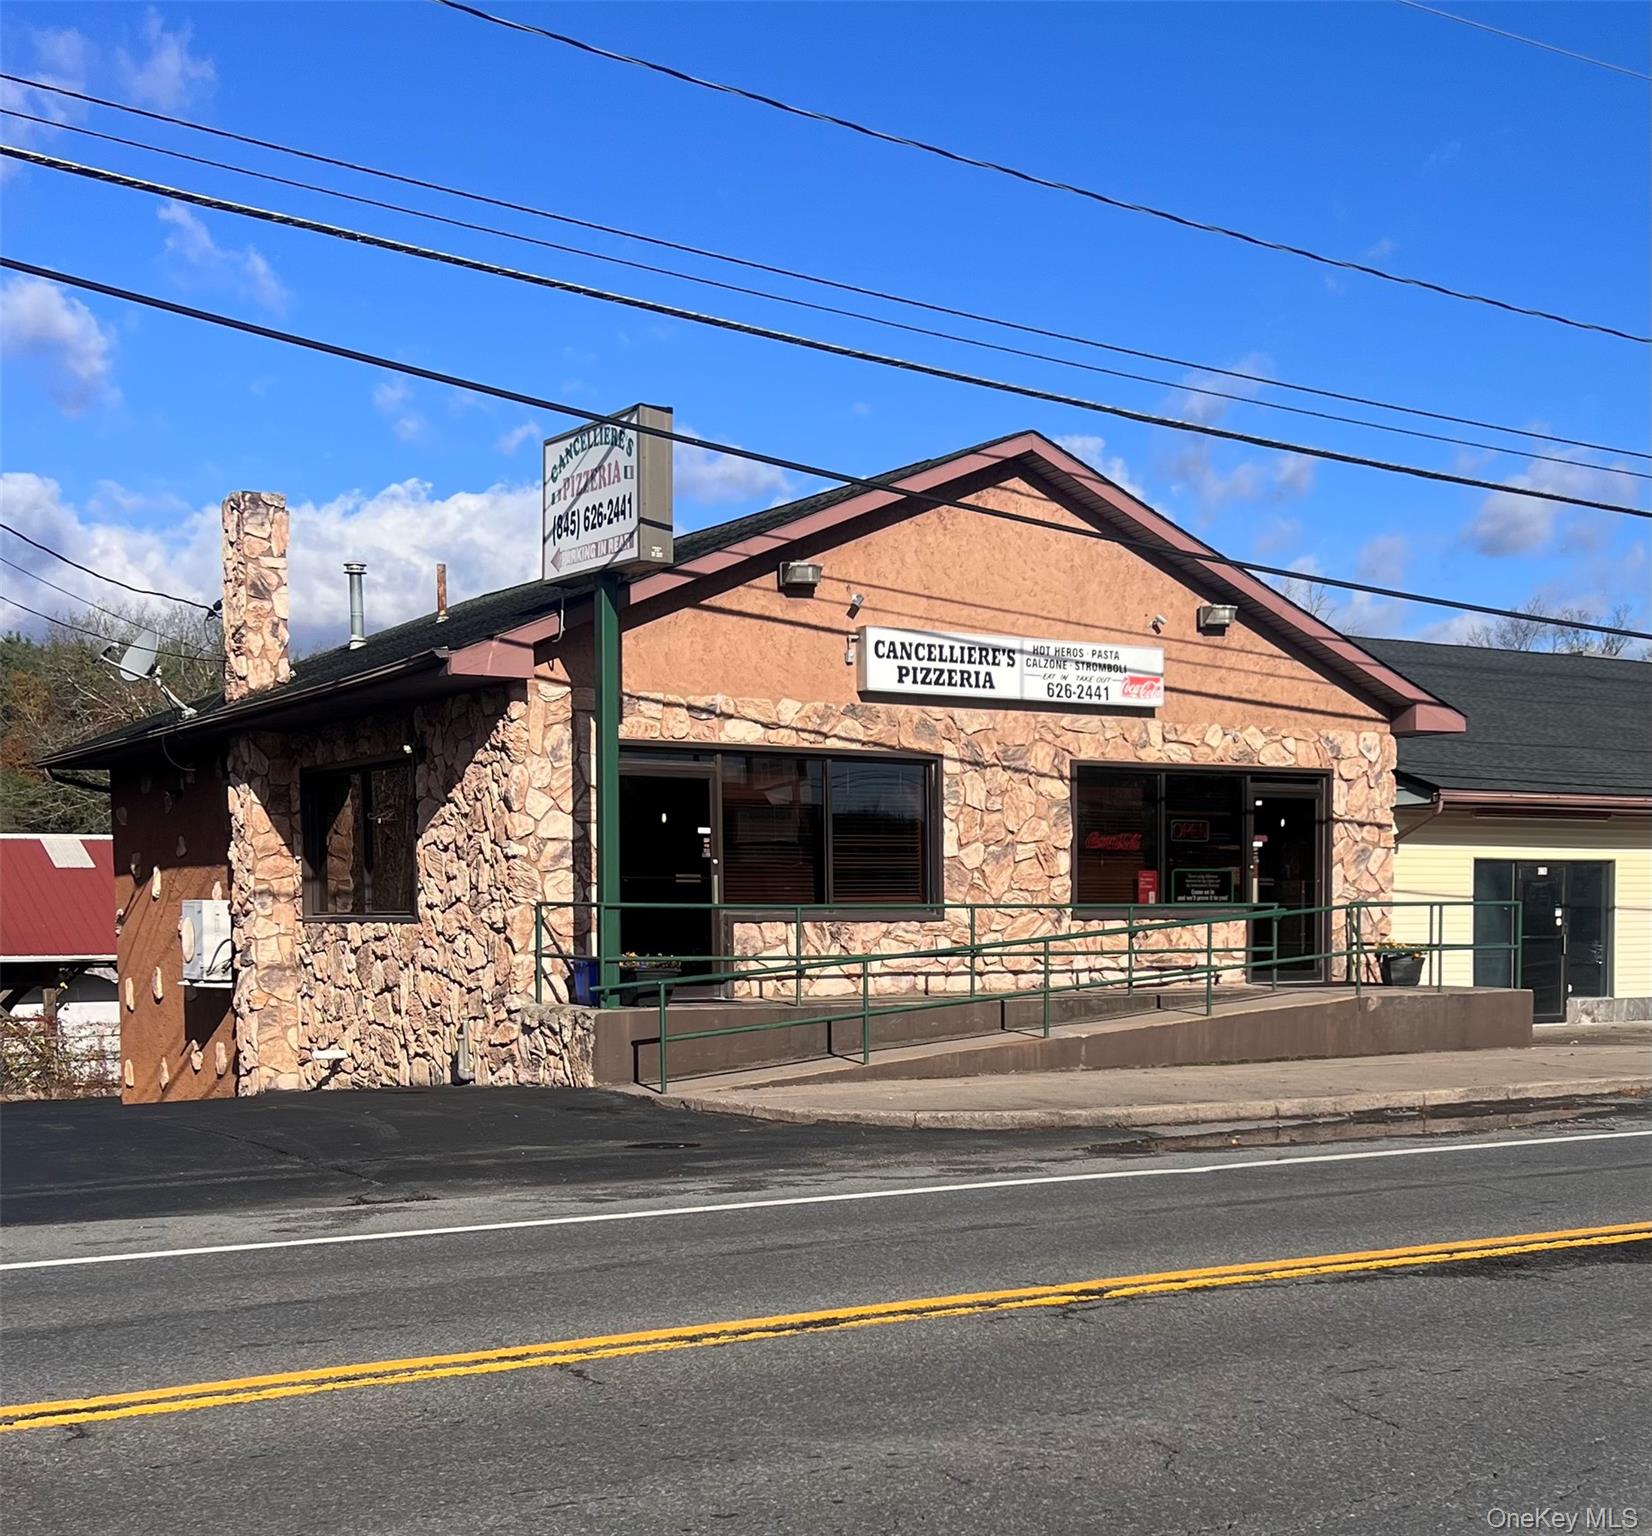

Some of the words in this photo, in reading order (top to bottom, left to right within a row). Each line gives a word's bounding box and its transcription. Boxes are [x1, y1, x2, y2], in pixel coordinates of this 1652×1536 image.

[550, 426, 634, 483] CANCELLIERE'S
[561, 459, 621, 501] PIZZERIA
[552, 509, 580, 546] (845)
[583, 492, 632, 532] 626-2441
[597, 540, 607, 557] IN
[874, 639, 1016, 667] CANCELLIERE'S
[1032, 645, 1051, 656] HOT
[1054, 647, 1084, 658] HEROS
[1091, 649, 1120, 661] PASTA
[1025, 658, 1067, 670] CALZONE
[1075, 661, 1127, 674] STROMBOLI
[897, 665, 996, 690] PIZZERIA
[1042, 672, 1056, 680] EAT
[1076, 675, 1094, 683] TAKE
[1046, 682, 1110, 701] 626-2441
